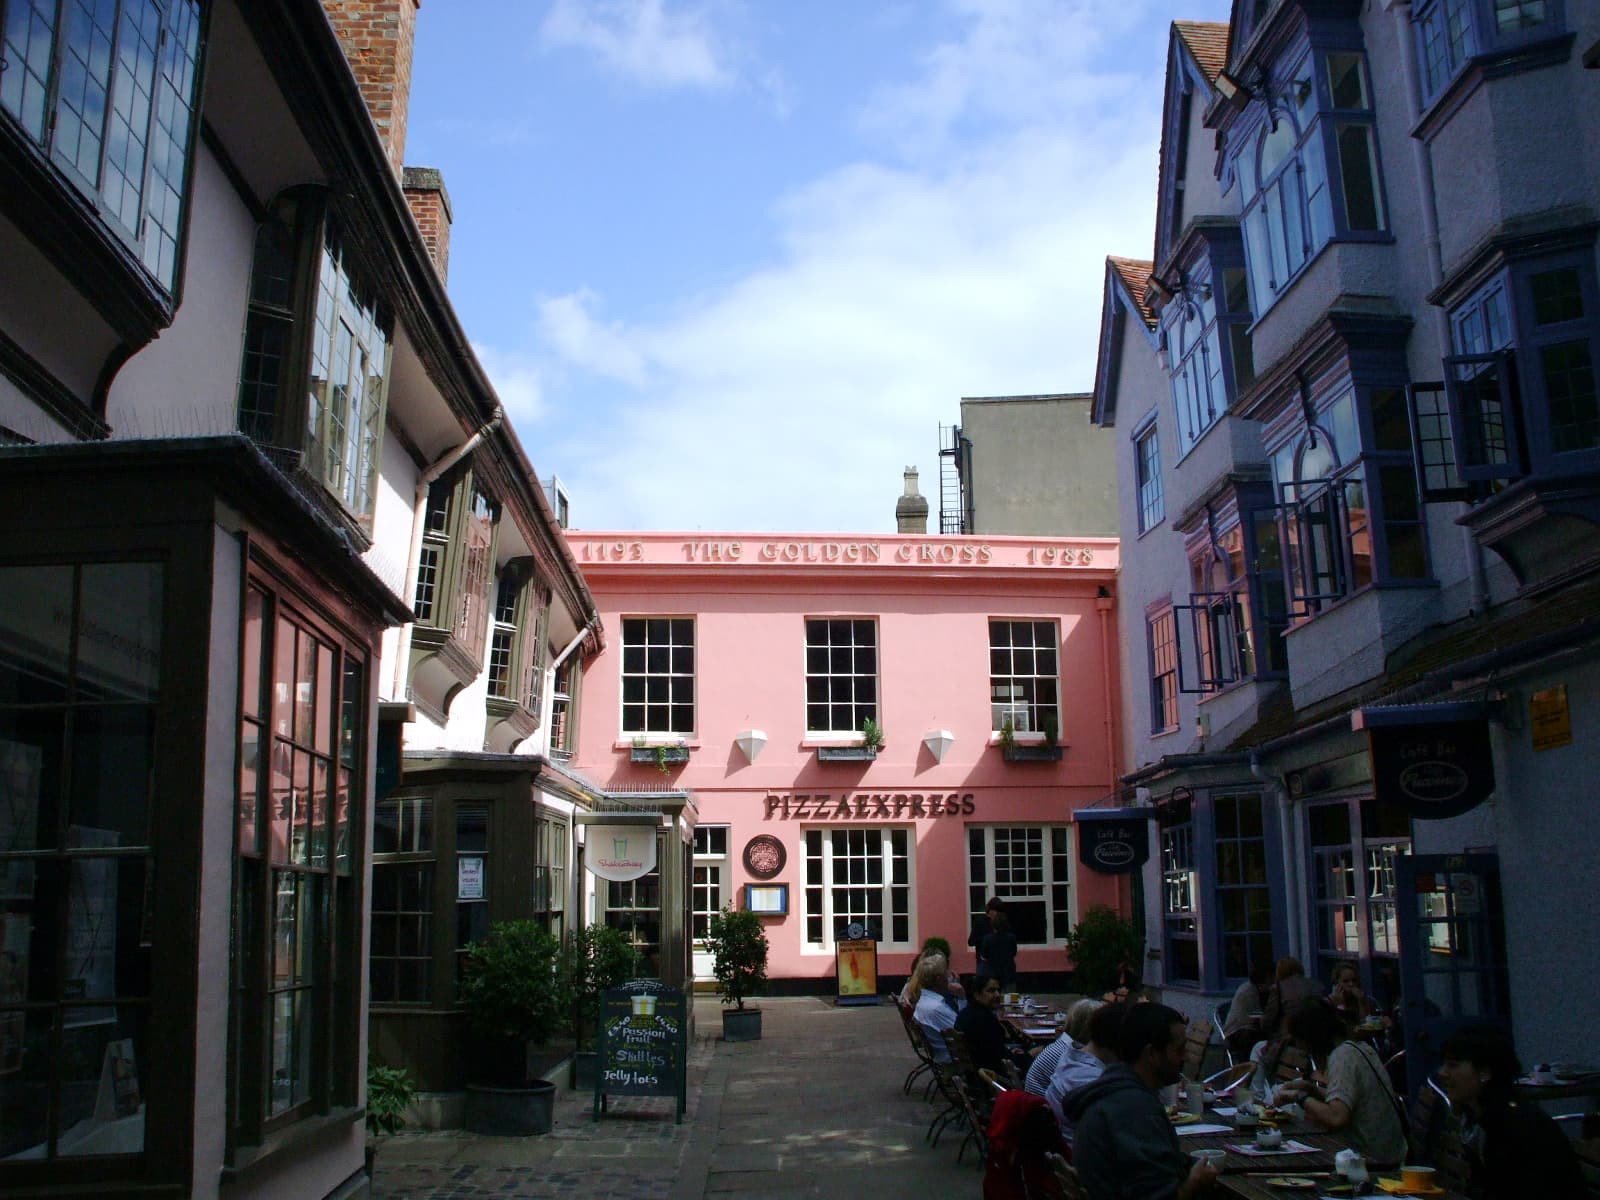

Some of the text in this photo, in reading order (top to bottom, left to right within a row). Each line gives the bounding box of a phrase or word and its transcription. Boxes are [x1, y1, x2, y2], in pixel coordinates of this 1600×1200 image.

[585, 540, 1095, 563] 1193 THE GOLDEN CROSS 1988
[765, 793, 976, 819] PIZZAEXPRESS
[622, 1027, 666, 1040] Passion
[603, 1069, 631, 1086] Jelly
